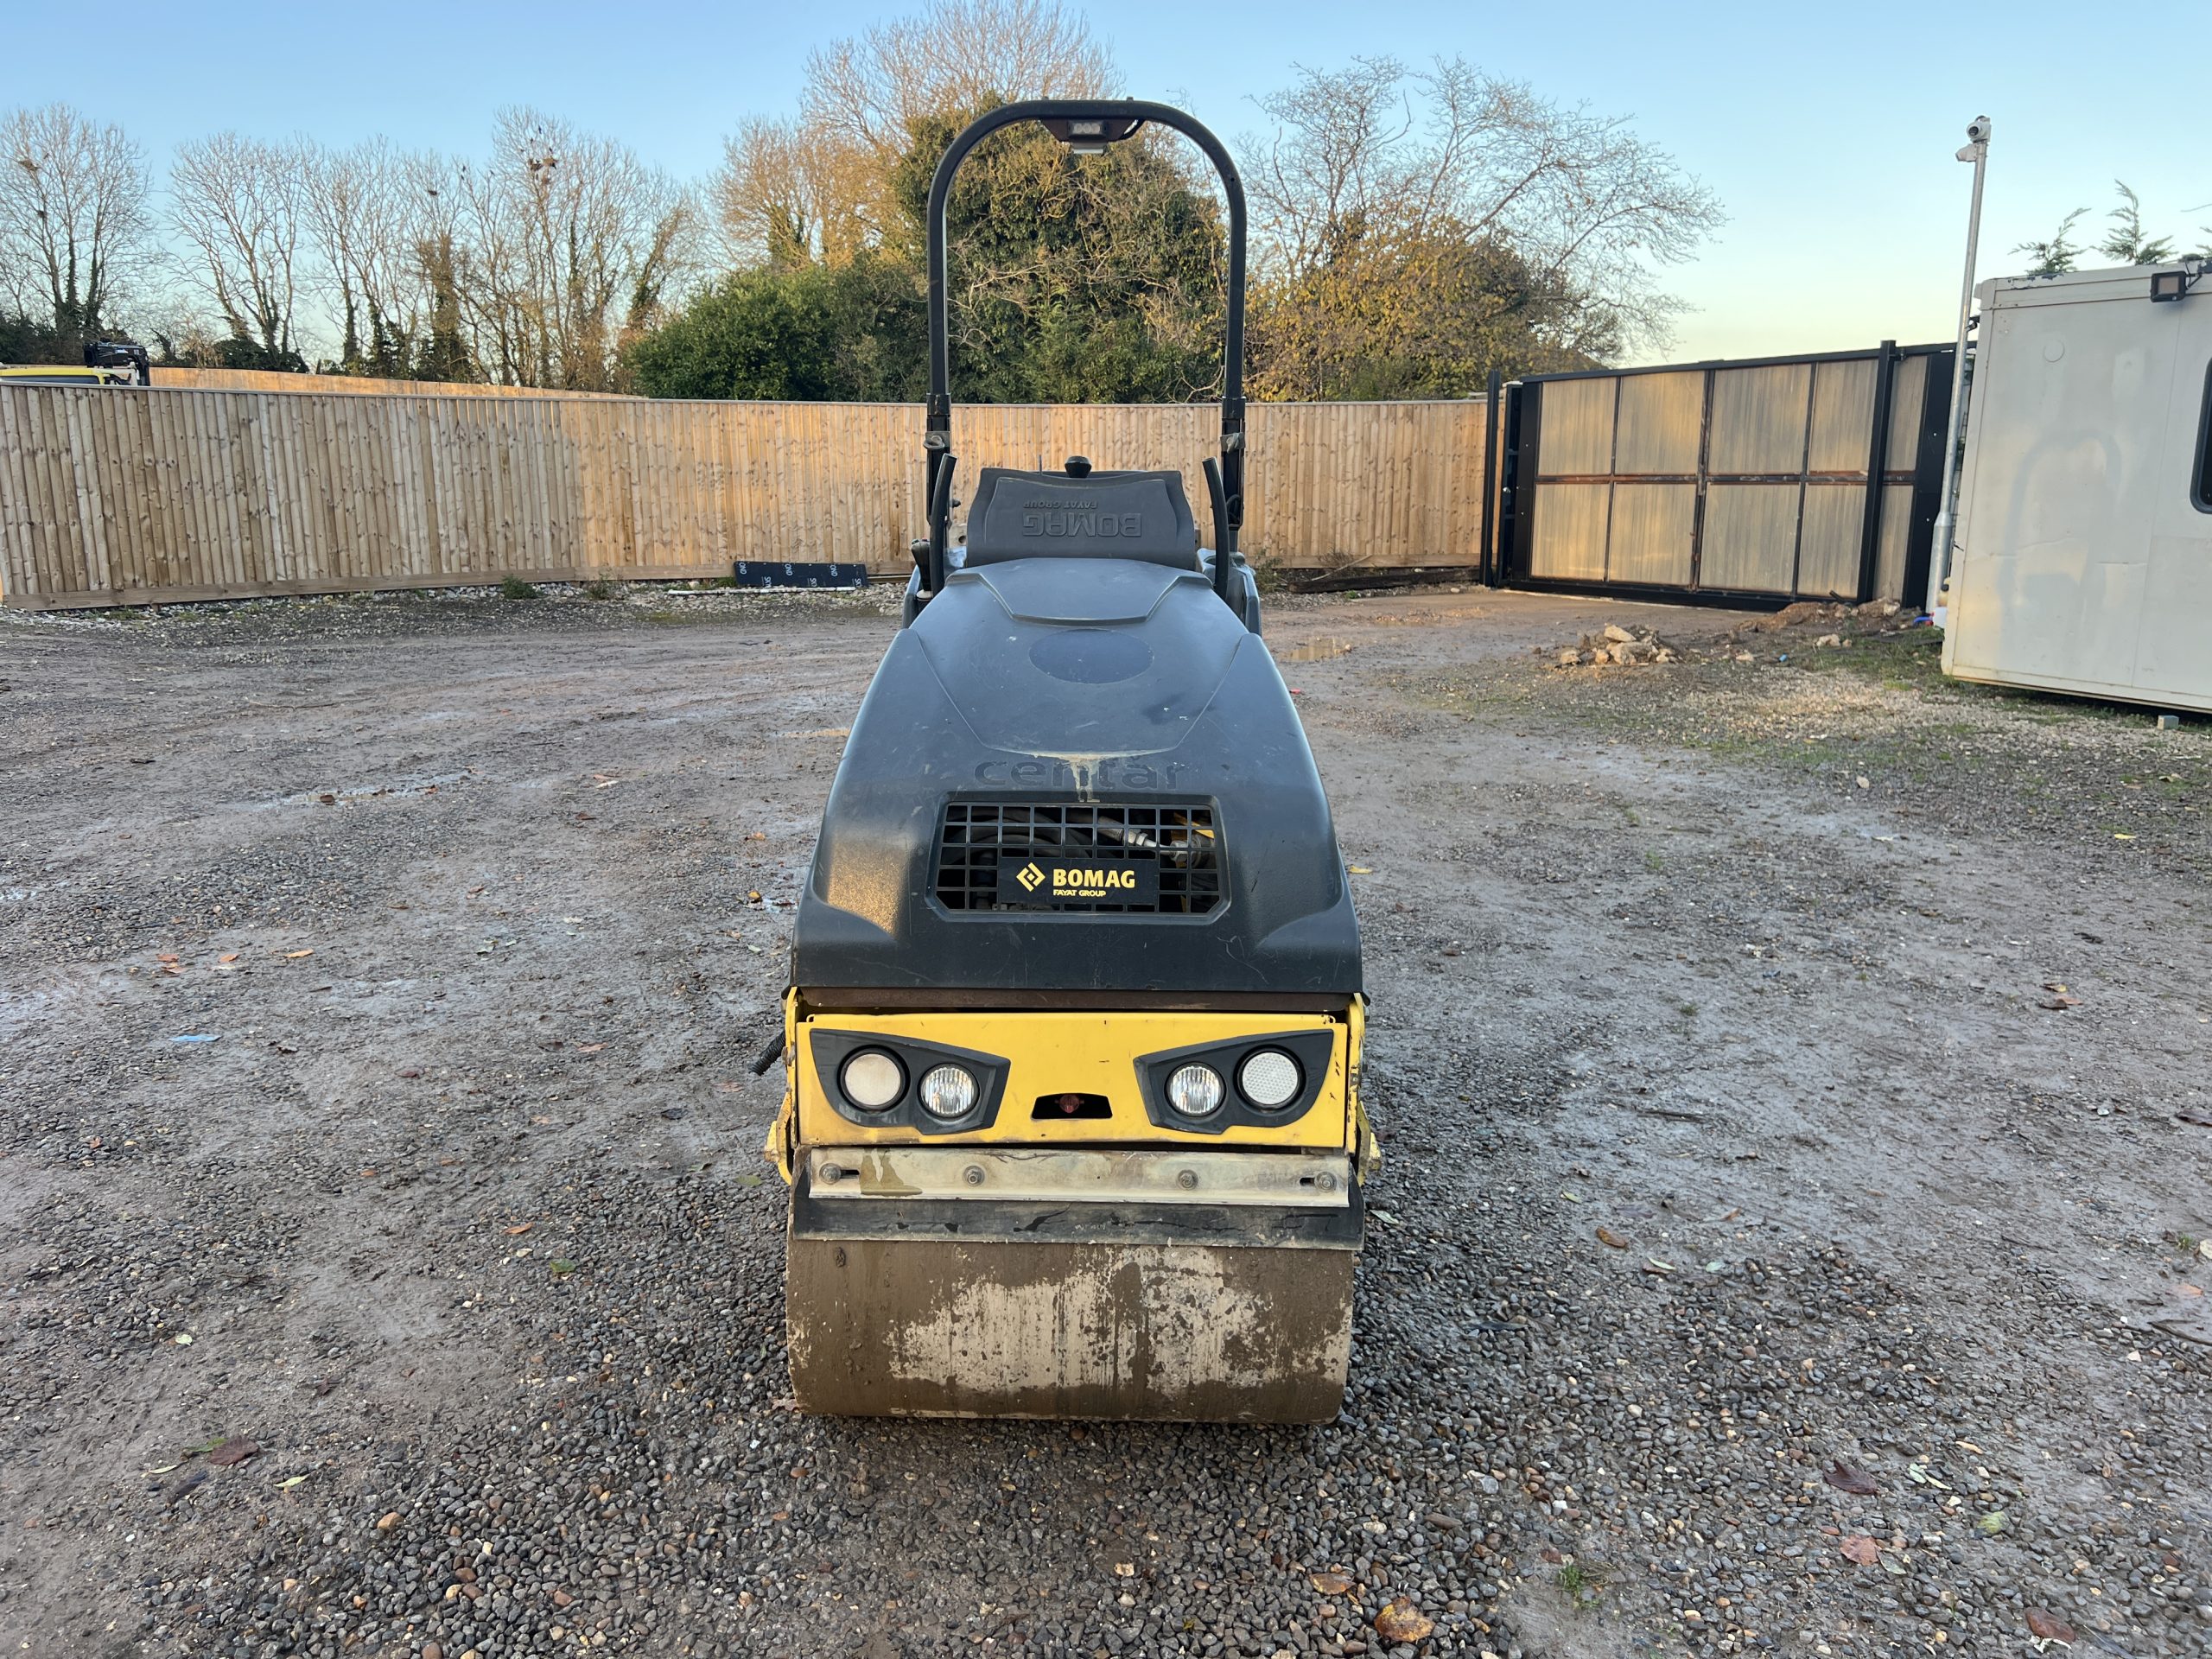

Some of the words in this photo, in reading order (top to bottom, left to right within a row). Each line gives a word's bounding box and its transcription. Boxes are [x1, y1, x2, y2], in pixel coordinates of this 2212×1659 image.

[1022, 499, 1061, 510] GROUP
[1063, 499, 1099, 510] FAYAT
[1022, 512, 1142, 537] BOMAG
[1052, 868, 1135, 888] BOMAG
